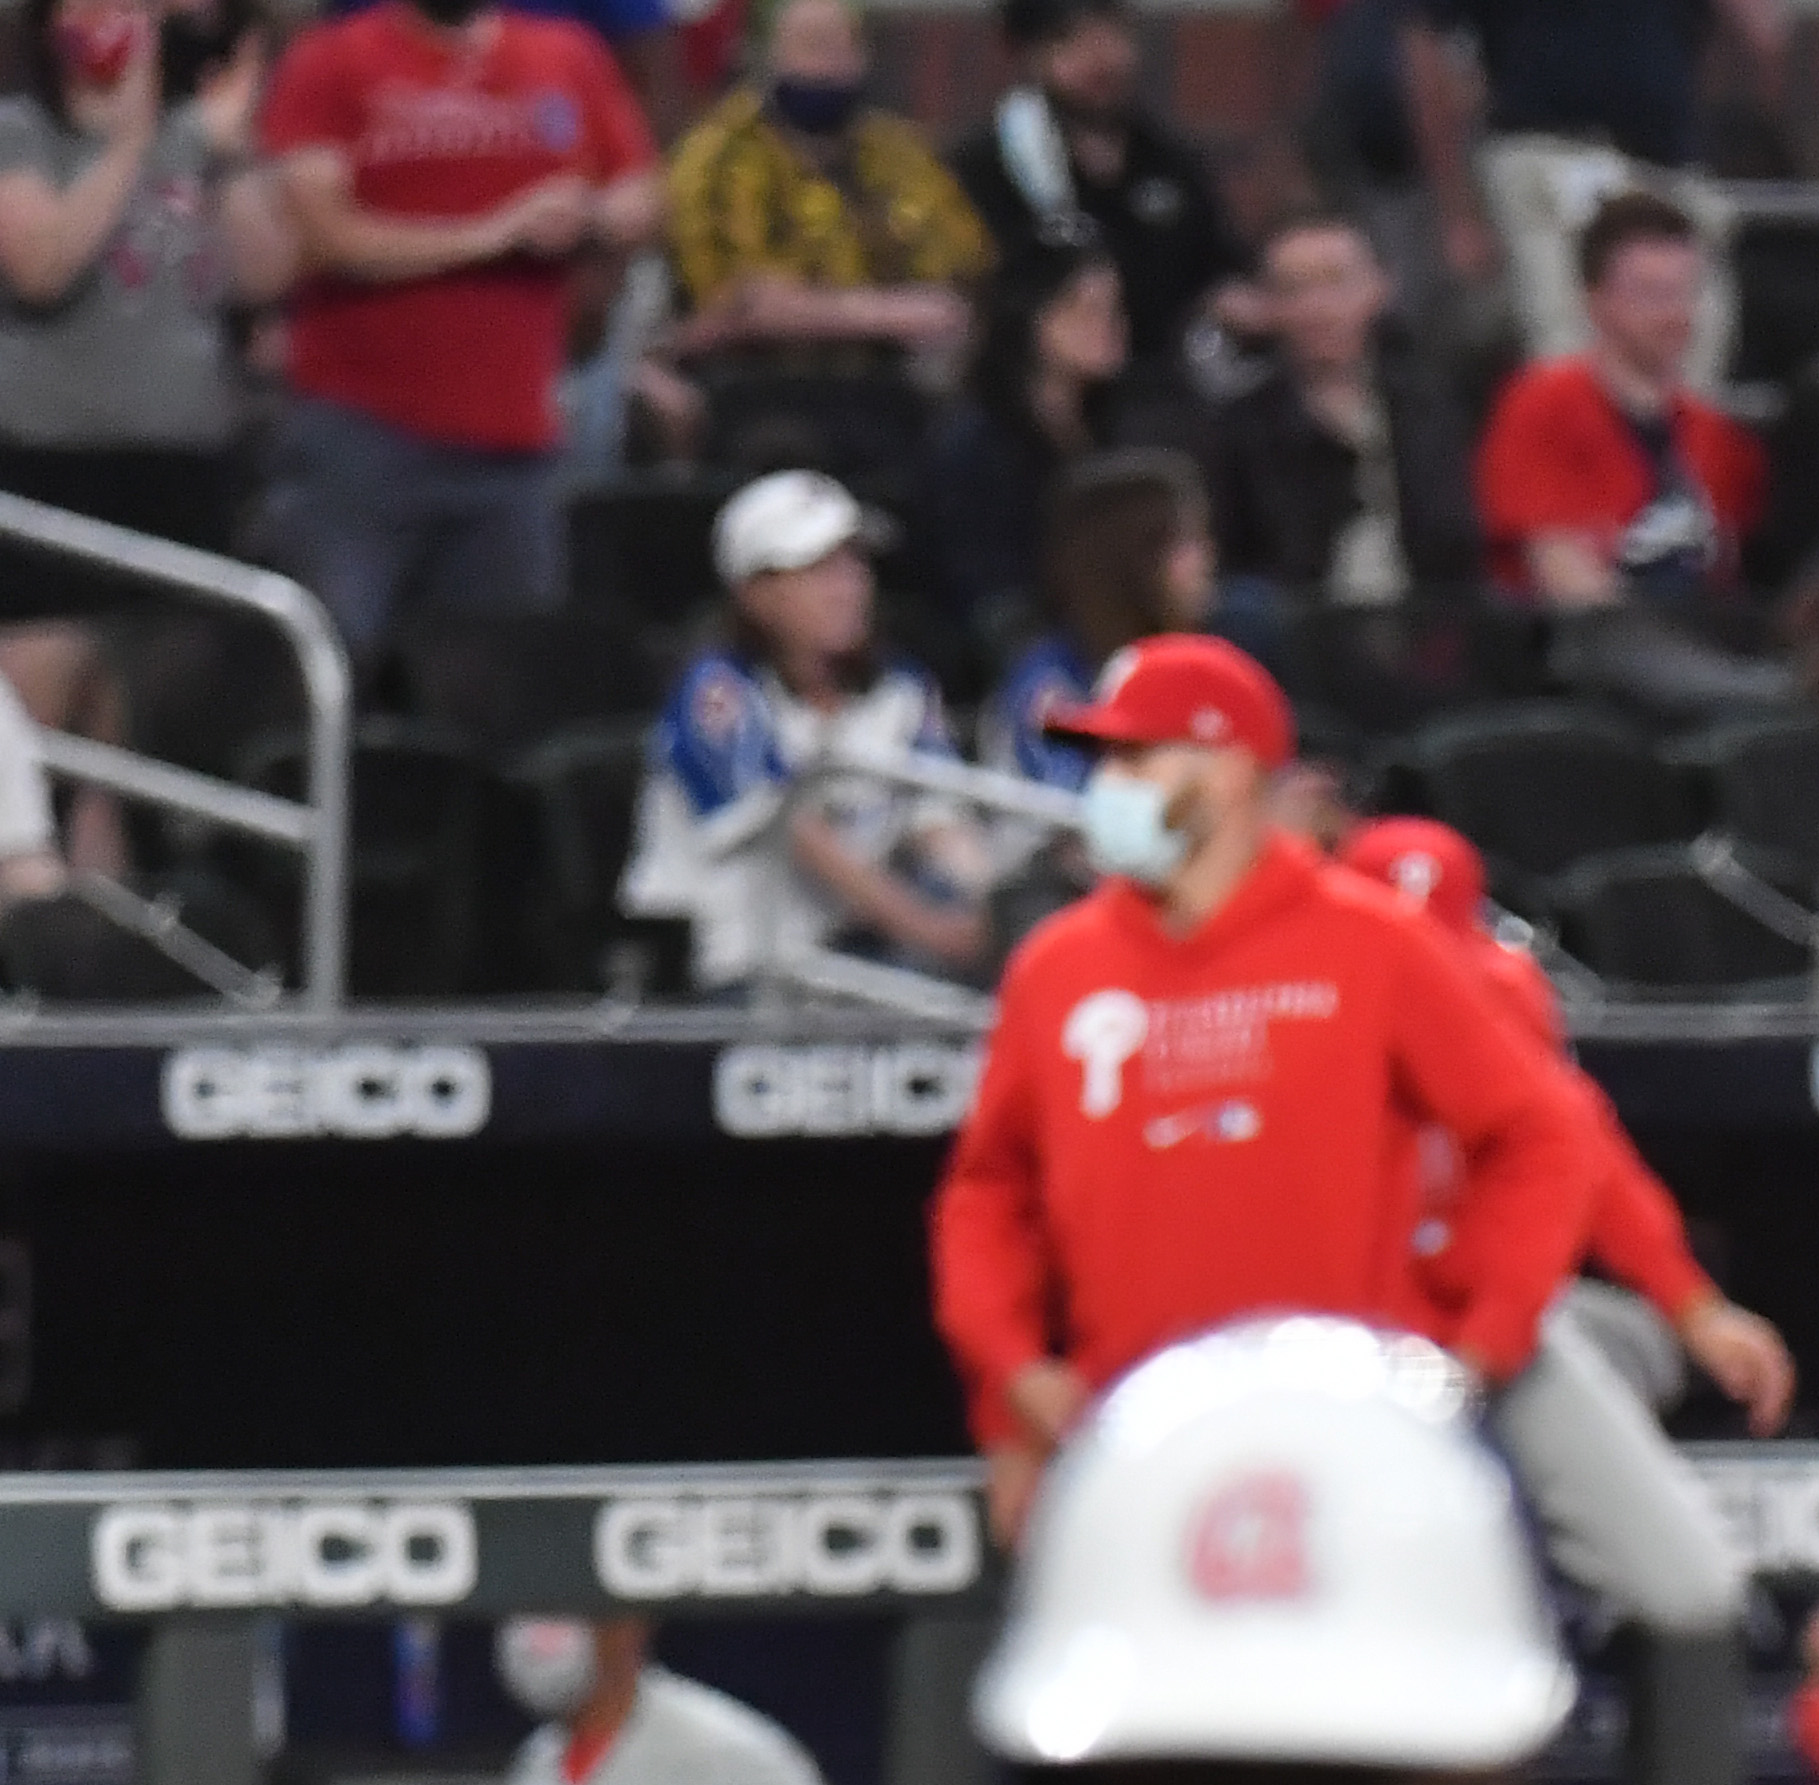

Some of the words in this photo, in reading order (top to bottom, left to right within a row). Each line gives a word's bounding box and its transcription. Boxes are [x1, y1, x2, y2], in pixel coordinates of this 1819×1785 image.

[160, 1041, 492, 1140] GEICO
[712, 1040, 985, 1140] GEIC
[93, 1500, 478, 1611] GEICO
[598, 1493, 982, 1597] GEICO
